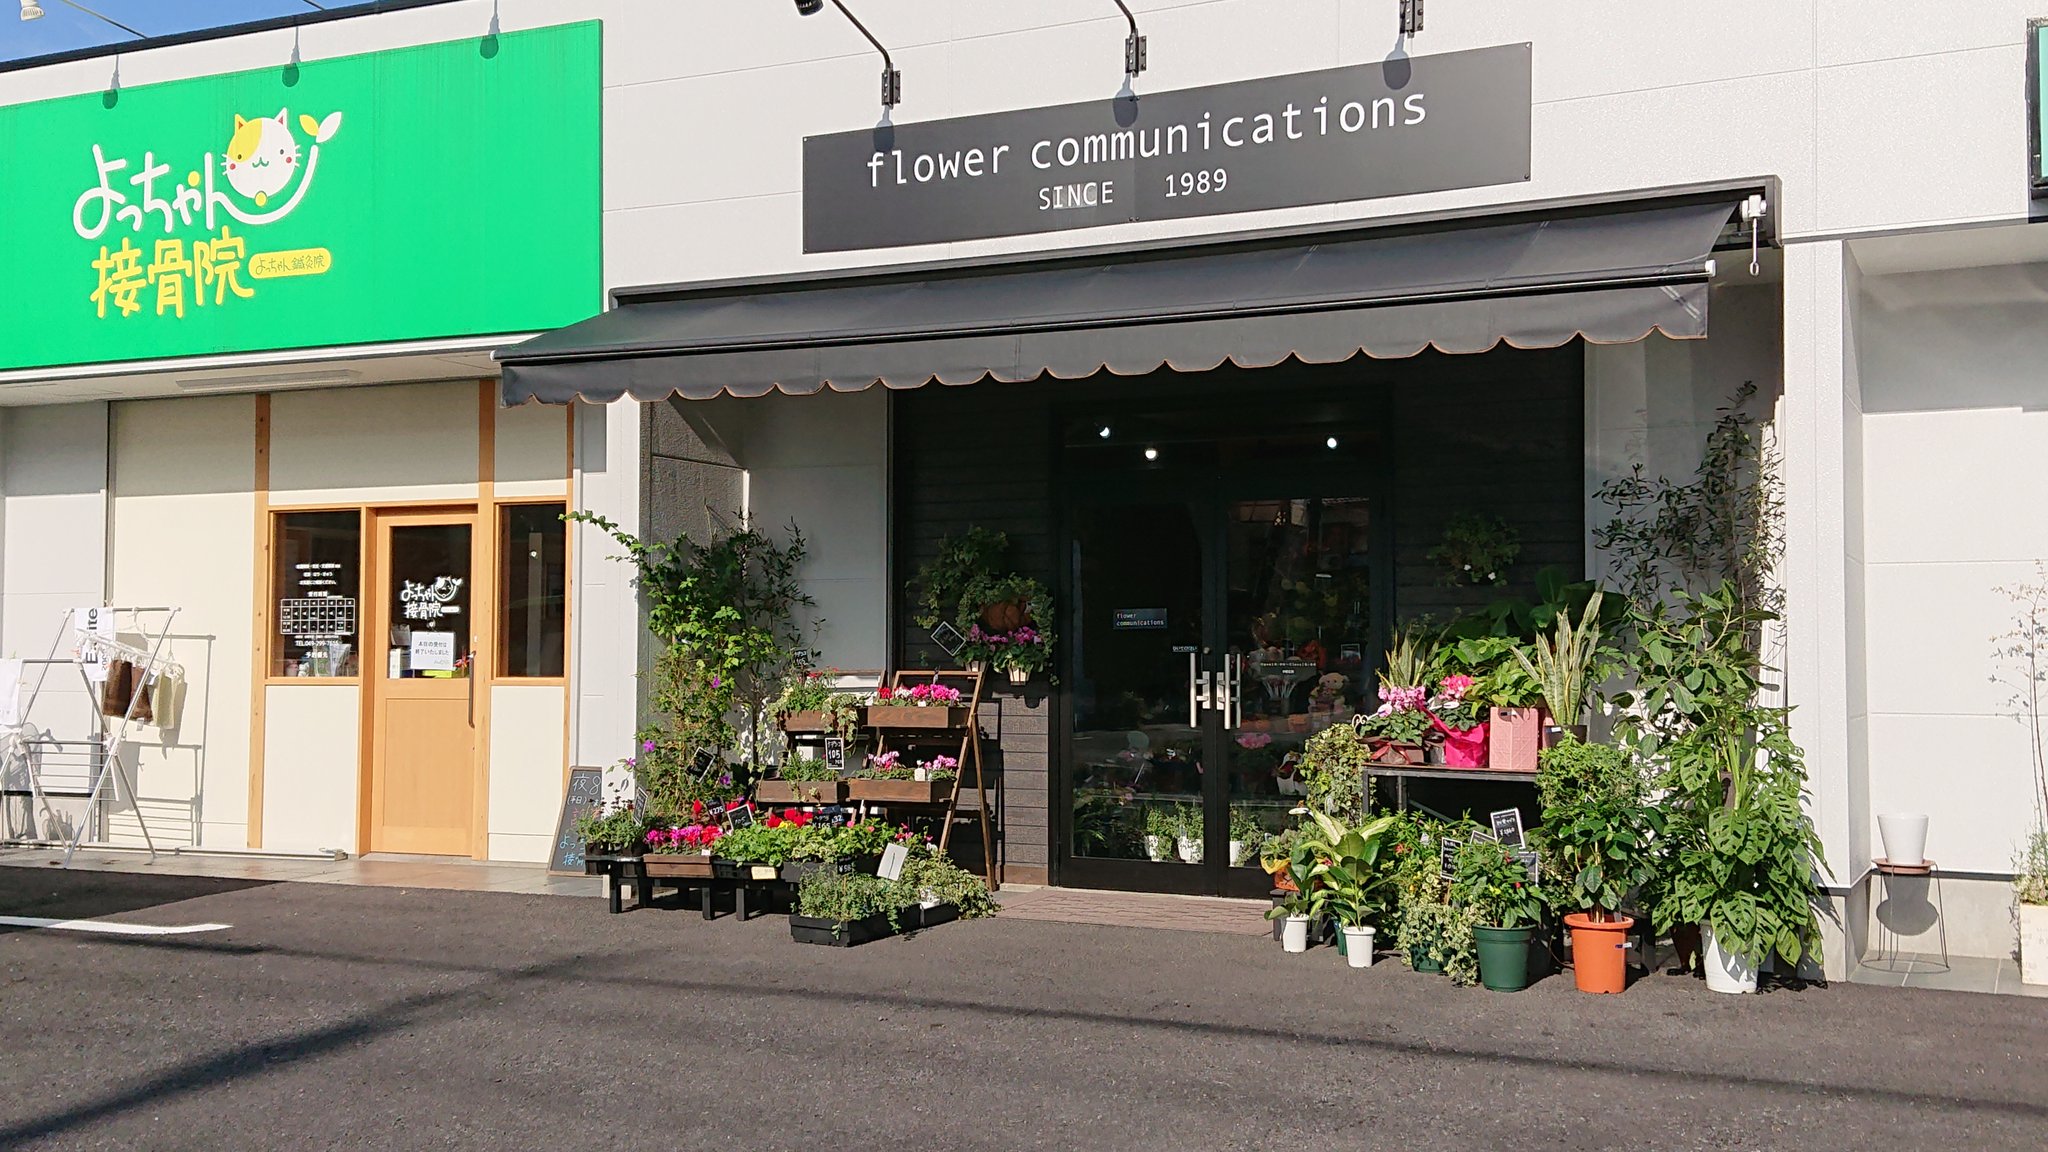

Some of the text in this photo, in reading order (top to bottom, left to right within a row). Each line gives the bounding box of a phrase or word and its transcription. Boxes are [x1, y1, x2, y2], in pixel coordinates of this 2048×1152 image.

[867, 93, 1426, 188] flower communications
[73, 144, 319, 240] よっちゃん
[1038, 168, 1228, 211] SINCE 1989
[90, 226, 256, 319] 接骨院
[403, 601, 443, 620] 接骨院
